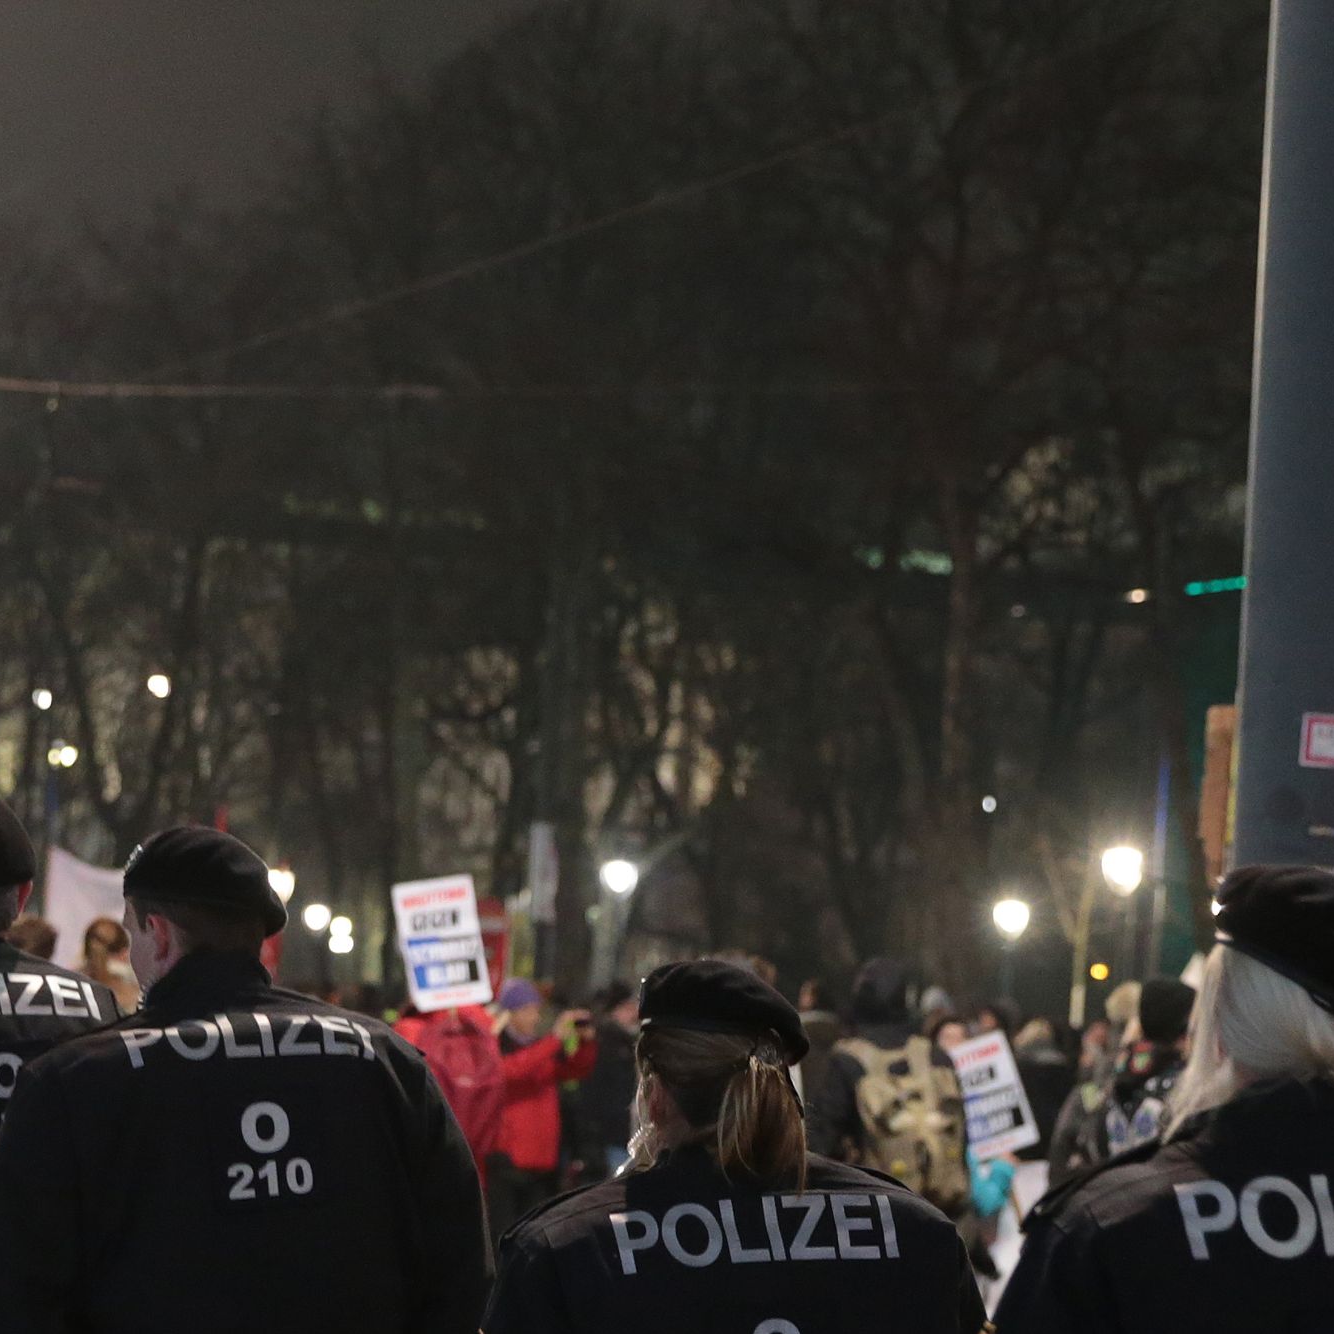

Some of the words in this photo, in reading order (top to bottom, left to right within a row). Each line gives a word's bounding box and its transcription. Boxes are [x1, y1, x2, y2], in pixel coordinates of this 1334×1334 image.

[120, 1013, 376, 1069] POLIZEI
[240, 1101, 291, 1154] O
[227, 1157, 314, 1200] 210
[609, 1194, 901, 1276] POLIZEI
